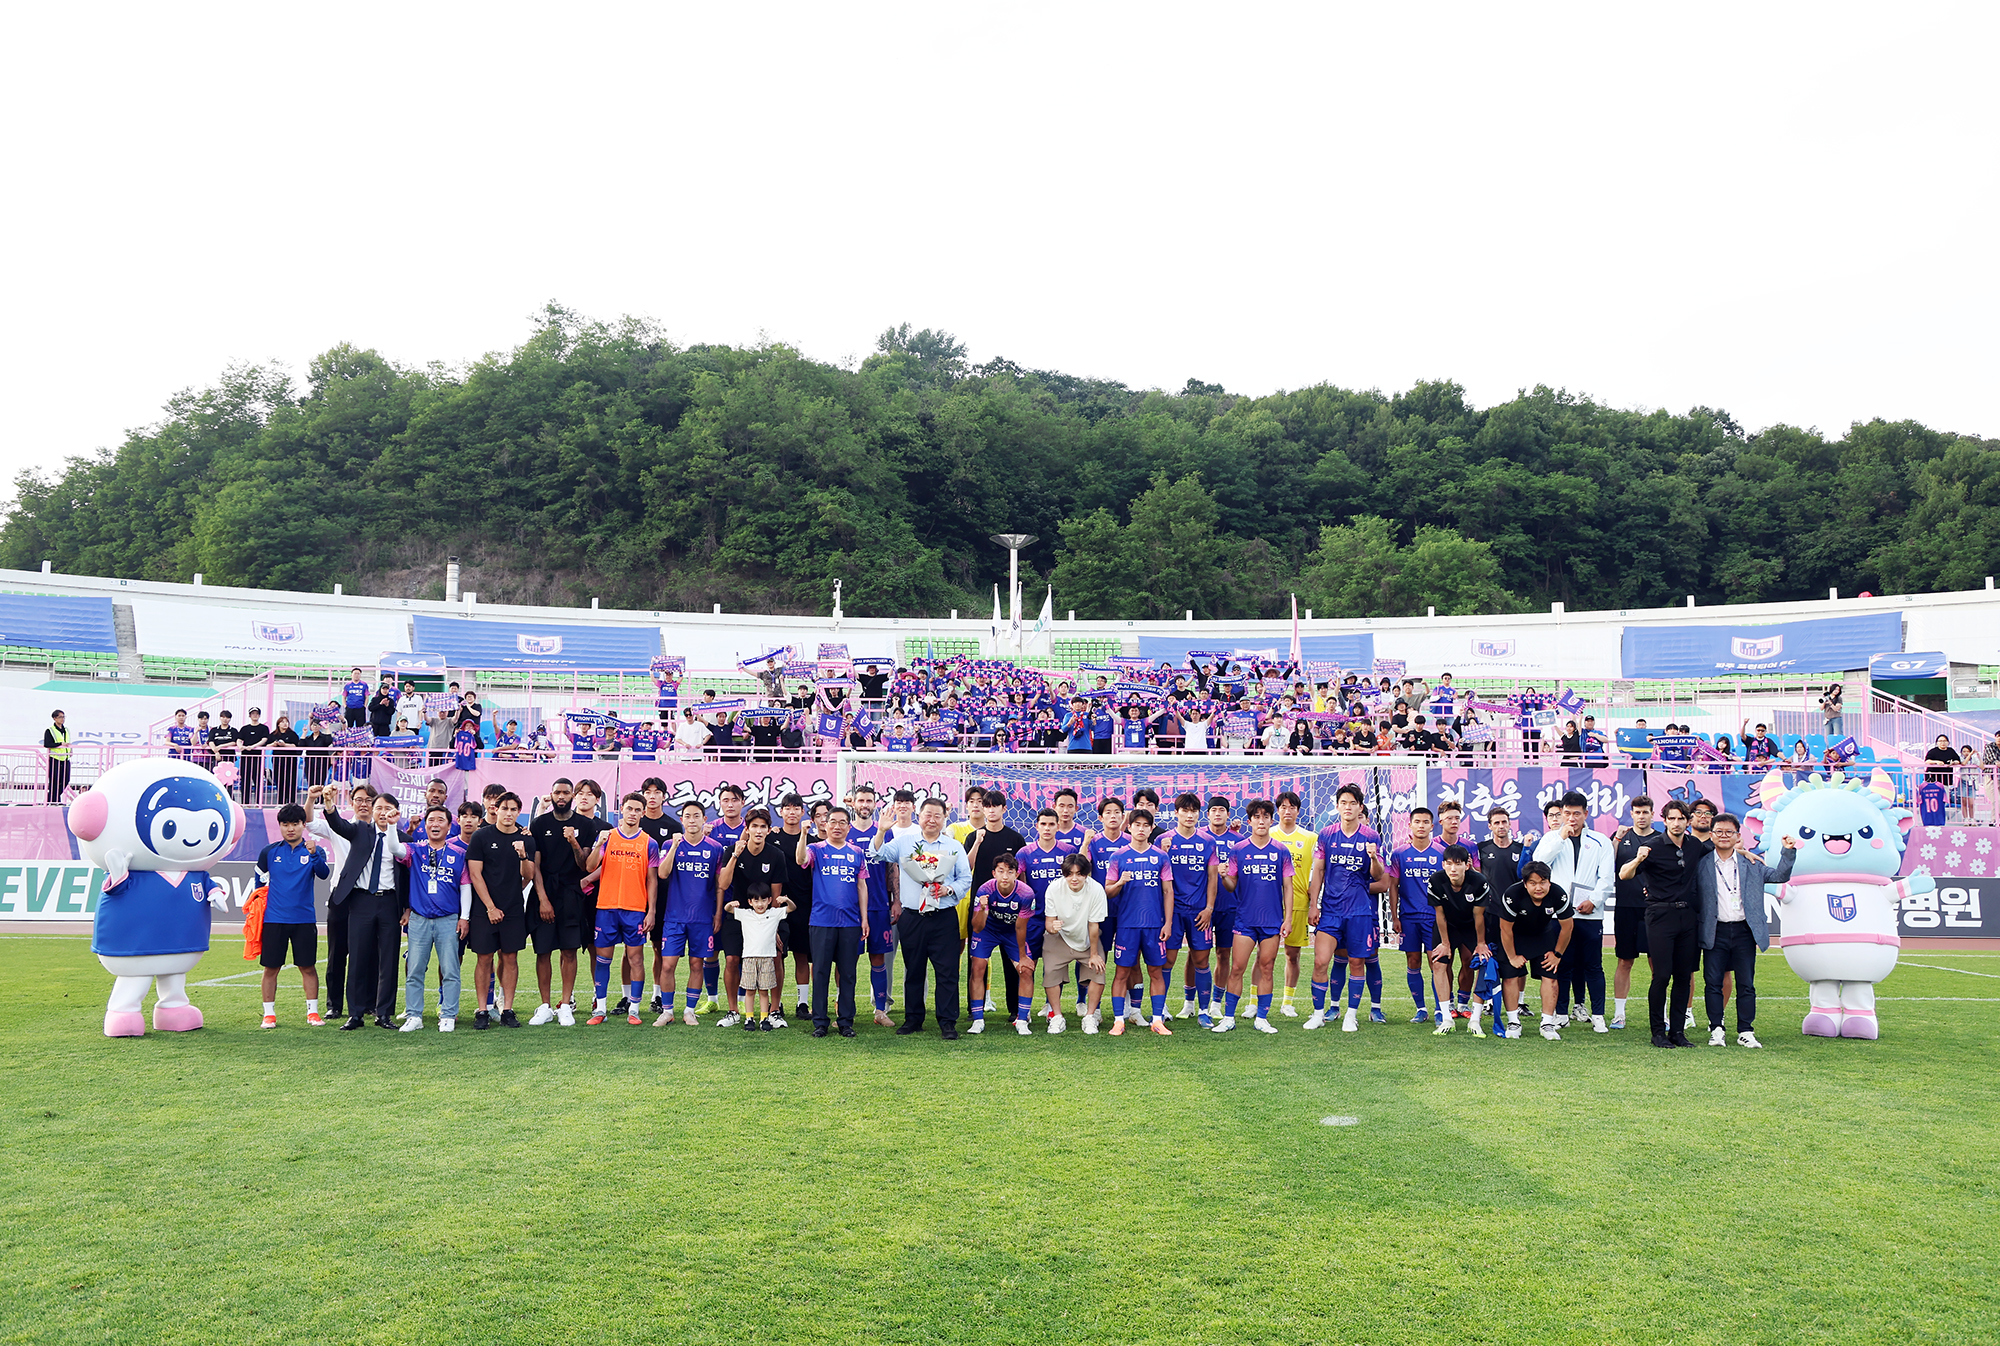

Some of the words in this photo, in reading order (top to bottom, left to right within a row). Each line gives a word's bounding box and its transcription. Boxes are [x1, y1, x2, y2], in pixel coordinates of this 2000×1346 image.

[396, 659, 428, 668] G4
[1779, 659, 1797, 667] FC
[1891, 660, 1927, 670] G7
[1925, 798, 1938, 813] 10
[610, 850, 637, 858] KELME
[1832, 898, 1840, 908] P
[1893, 887, 1983, 928] 병원
[1844, 907, 1852, 917] F
[708, 935, 714, 949] 8
[1366, 934, 1372, 948] 6
